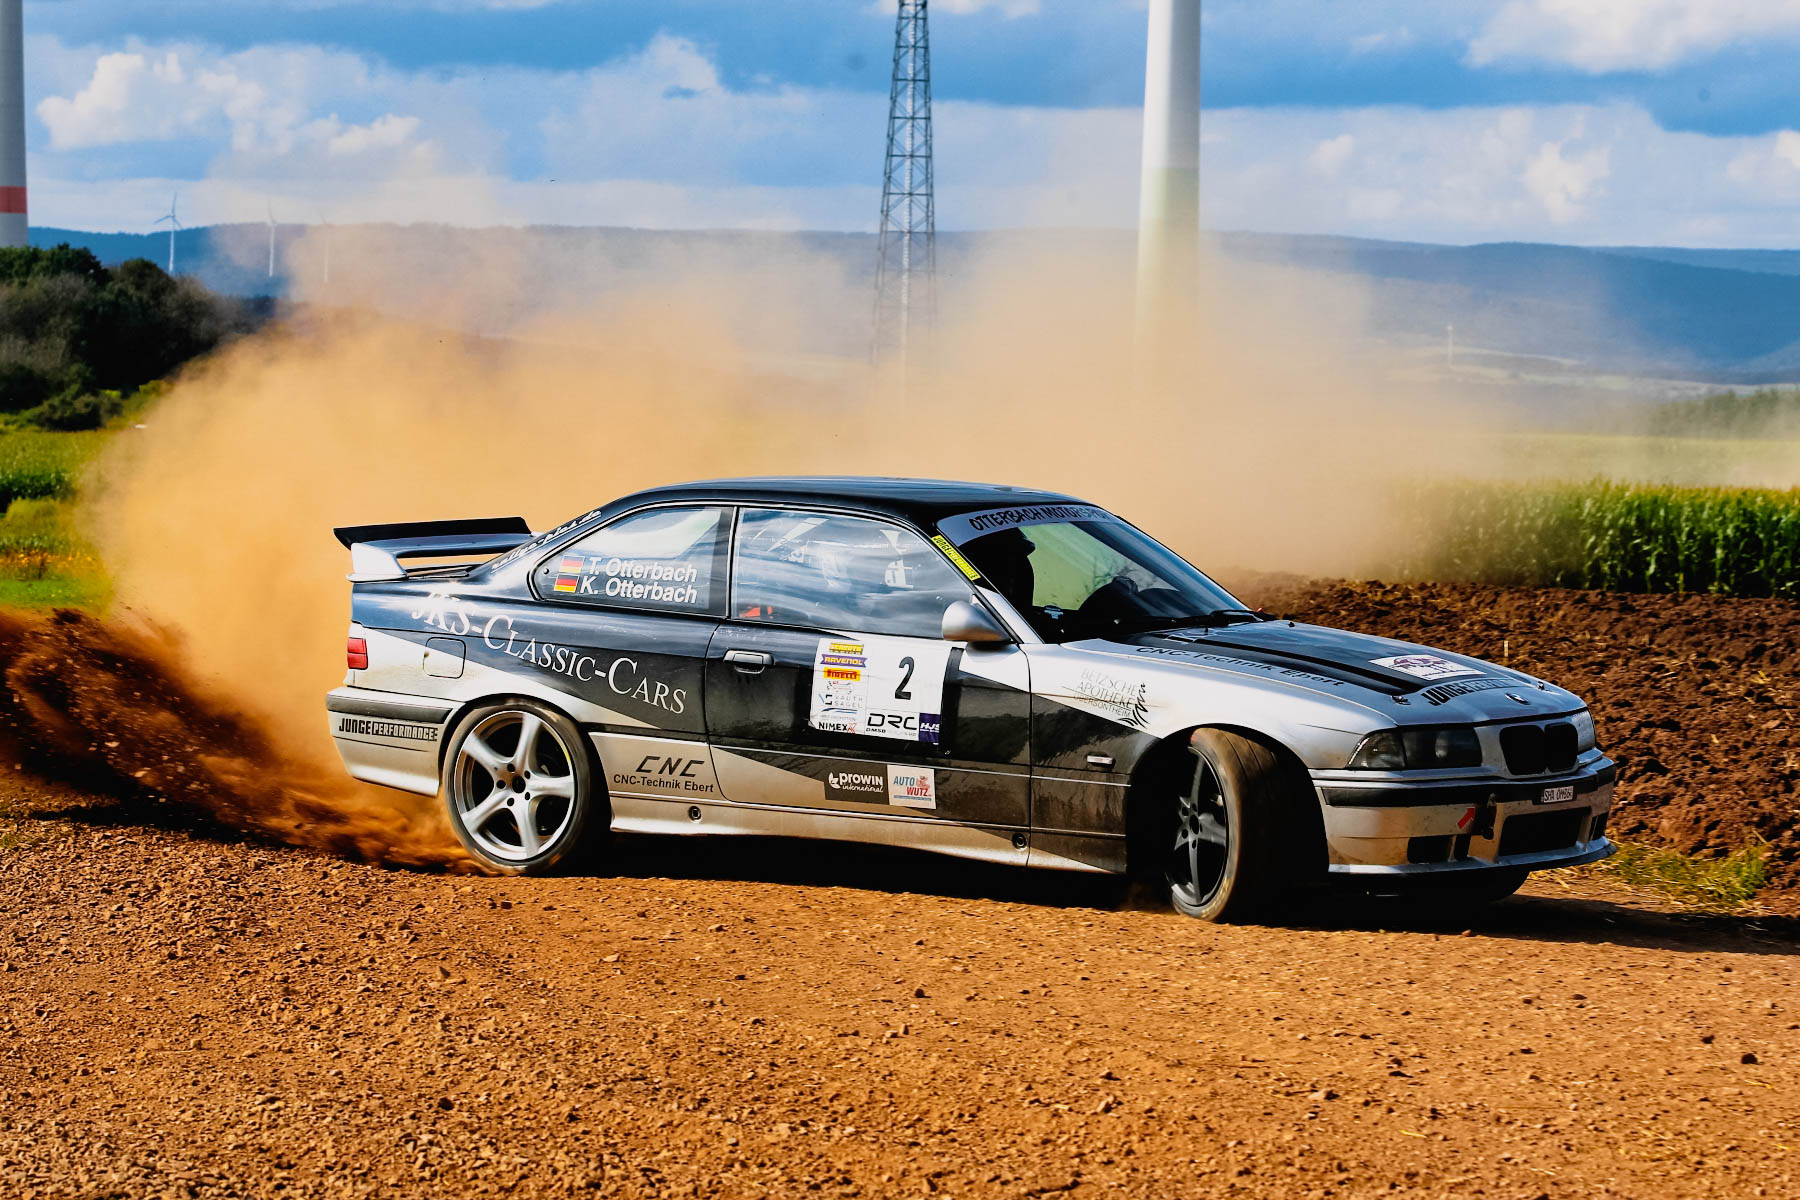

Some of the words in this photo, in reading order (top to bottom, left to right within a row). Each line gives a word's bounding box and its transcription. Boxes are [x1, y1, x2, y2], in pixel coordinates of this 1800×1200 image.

[968, 507, 1043, 531] OTTERBACH
[588, 556, 600, 575] T.
[605, 557, 698, 583] Otterbach
[580, 575, 599, 595] K.
[605, 577, 698, 604] Otterbach
[827, 669, 858, 680] PIRELLI
[895, 656, 914, 700] 2
[1076, 681, 1136, 709] APOTHEKE
[338, 717, 372, 735] JUNGE
[373, 721, 437, 741] PERFORMANCE
[867, 712, 918, 731] DRC
[635, 755, 705, 778] CNC
[613, 773, 681, 790] CNC-Technik
[684, 780, 714, 793] Ebert
[842, 783, 884, 793] international
[893, 775, 915, 786] AUTO
[907, 786, 929, 797] WUTZ
